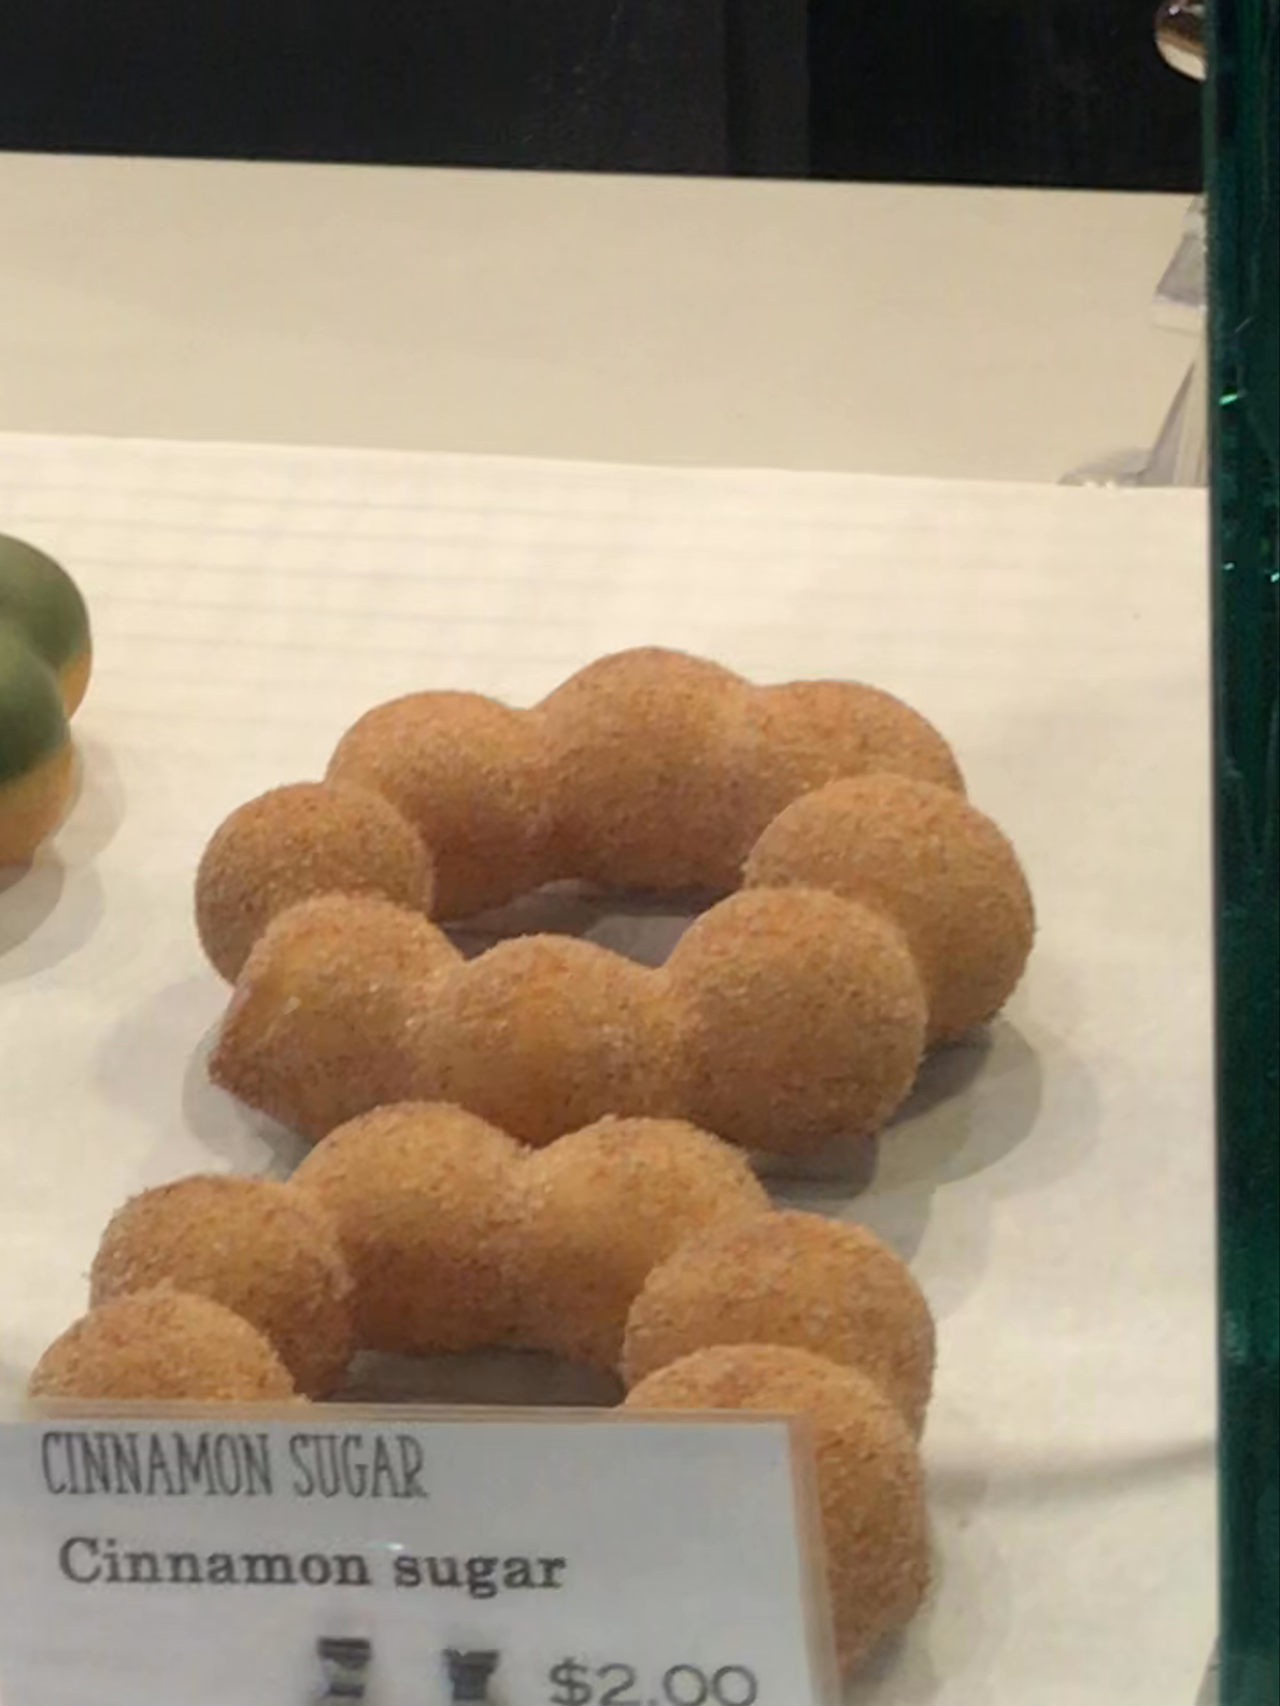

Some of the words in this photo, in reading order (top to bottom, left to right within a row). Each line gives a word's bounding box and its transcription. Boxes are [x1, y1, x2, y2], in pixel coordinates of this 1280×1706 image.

[42, 1431, 272, 1499] CINNAMON
[291, 1433, 430, 1501] SUGAR
[58, 1536, 372, 1587] Cinnamon
[394, 1551, 567, 1600] sugar
